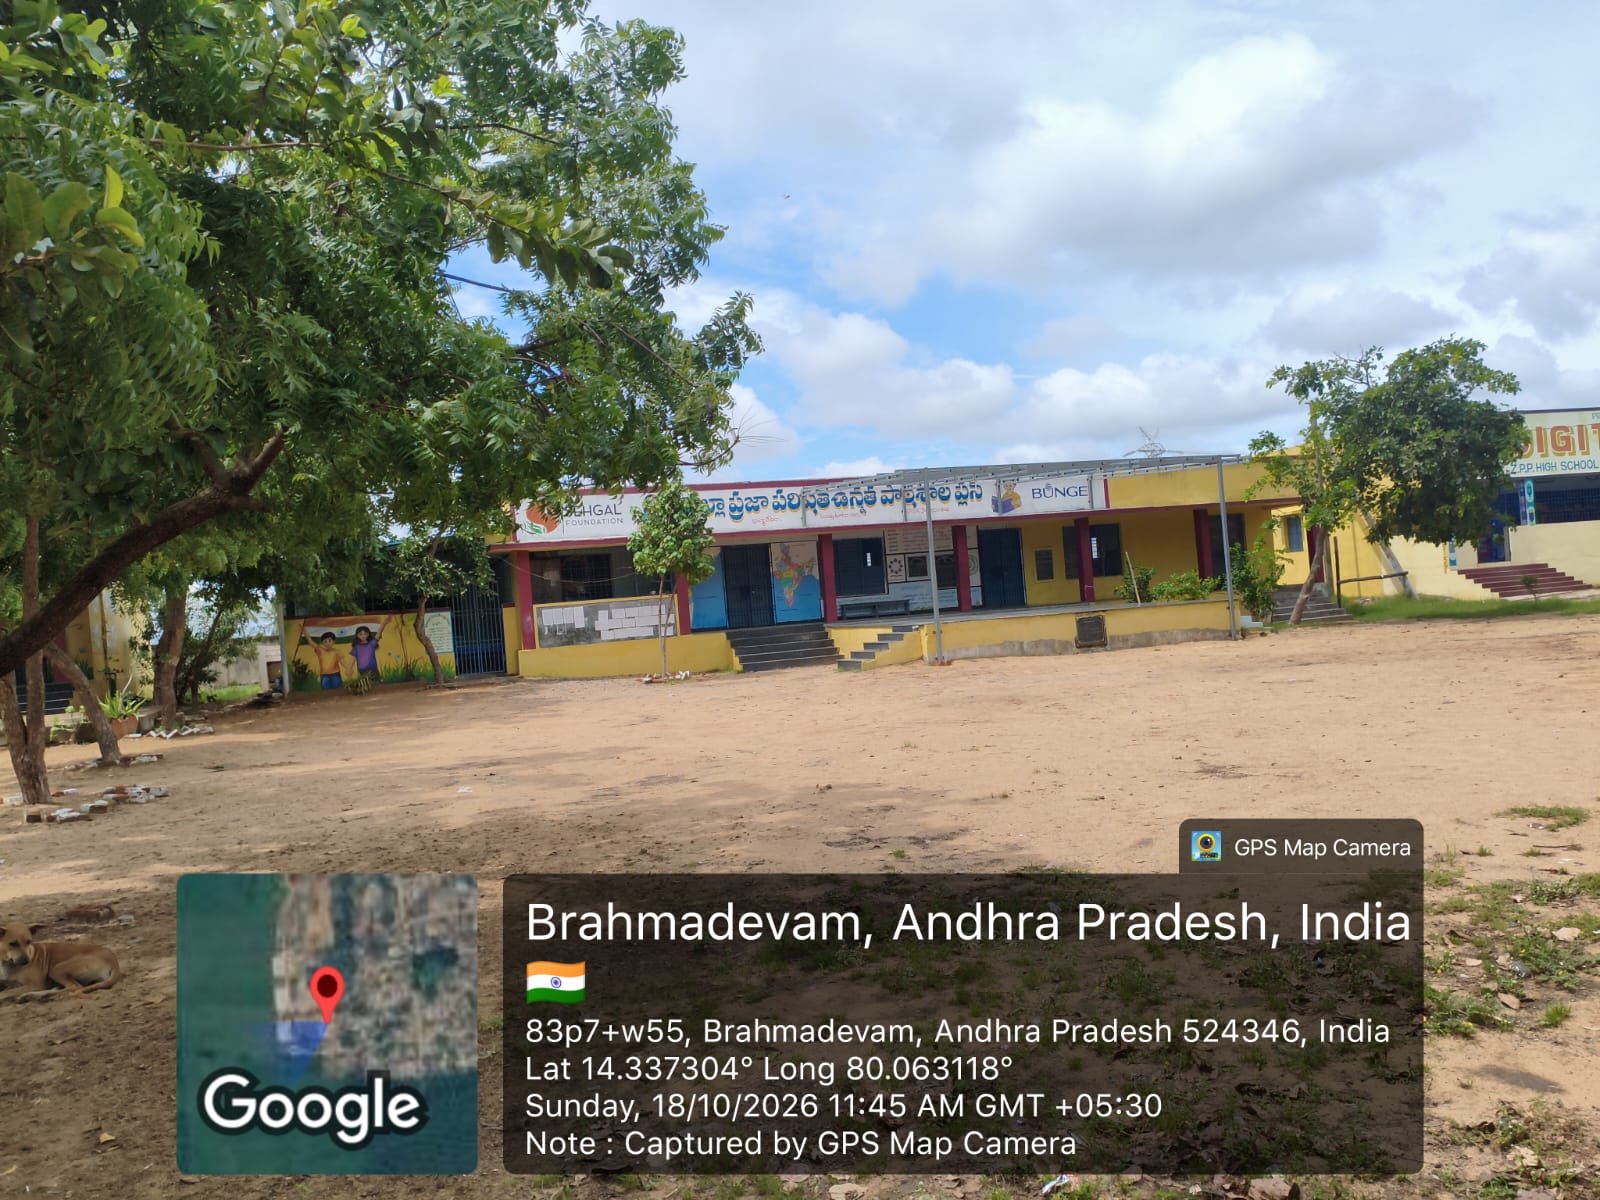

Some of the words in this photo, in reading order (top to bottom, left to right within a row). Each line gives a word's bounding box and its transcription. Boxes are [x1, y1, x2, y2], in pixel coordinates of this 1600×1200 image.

[1513, 423, 1600, 458] IGI
[1536, 461, 1557, 472] HIGH
[1560, 459, 1599, 471] SCHOOL
[1031, 483, 1089, 499] BUNGE
[565, 517, 624, 527] FOUNDATION
